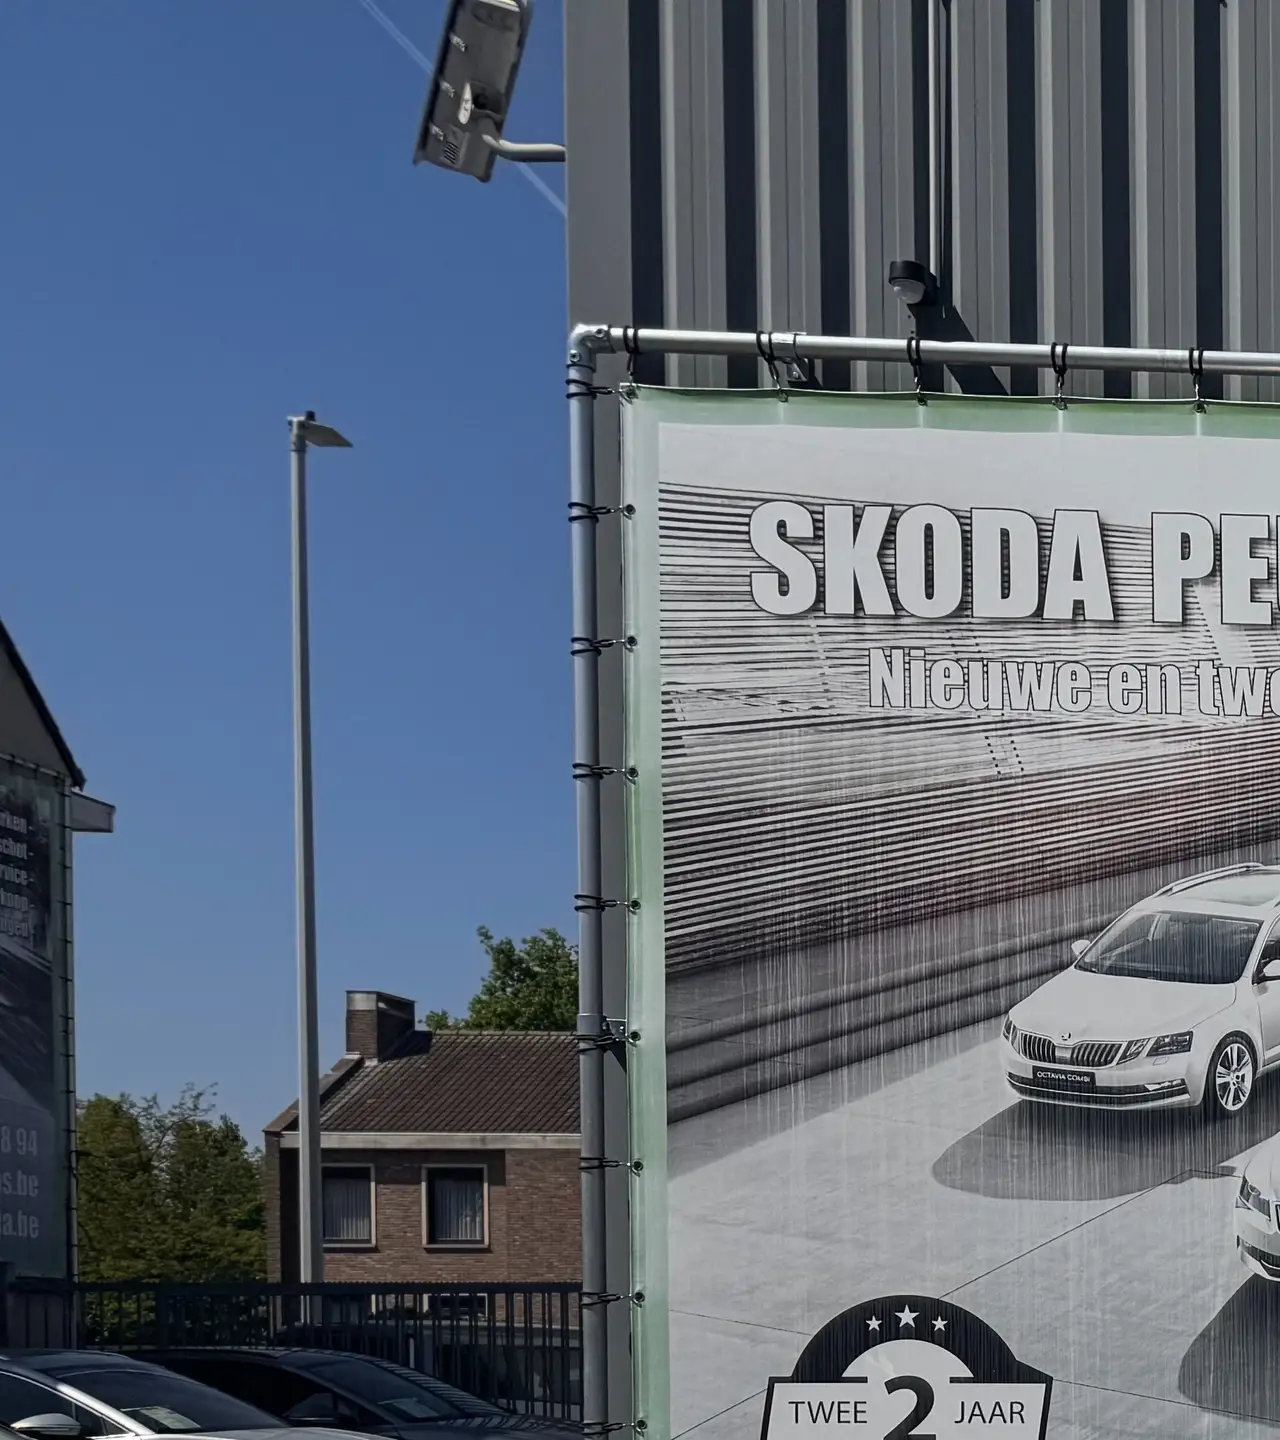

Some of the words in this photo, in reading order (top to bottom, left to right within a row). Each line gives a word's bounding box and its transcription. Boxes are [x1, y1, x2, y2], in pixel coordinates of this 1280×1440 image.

[748, 500, 1114, 620] SKODA
[869, 648, 1091, 712] Nieuwe
[1108, 662, 1182, 715] en
[1037, 1070, 1066, 1080] OCTAVIA
[16, 1128, 37, 1156] 94
[0, 1170, 39, 1197] s.be
[0, 1210, 39, 1238] a.be
[788, 1401, 868, 1424] TWEE
[954, 1401, 1025, 1424] JAAR
